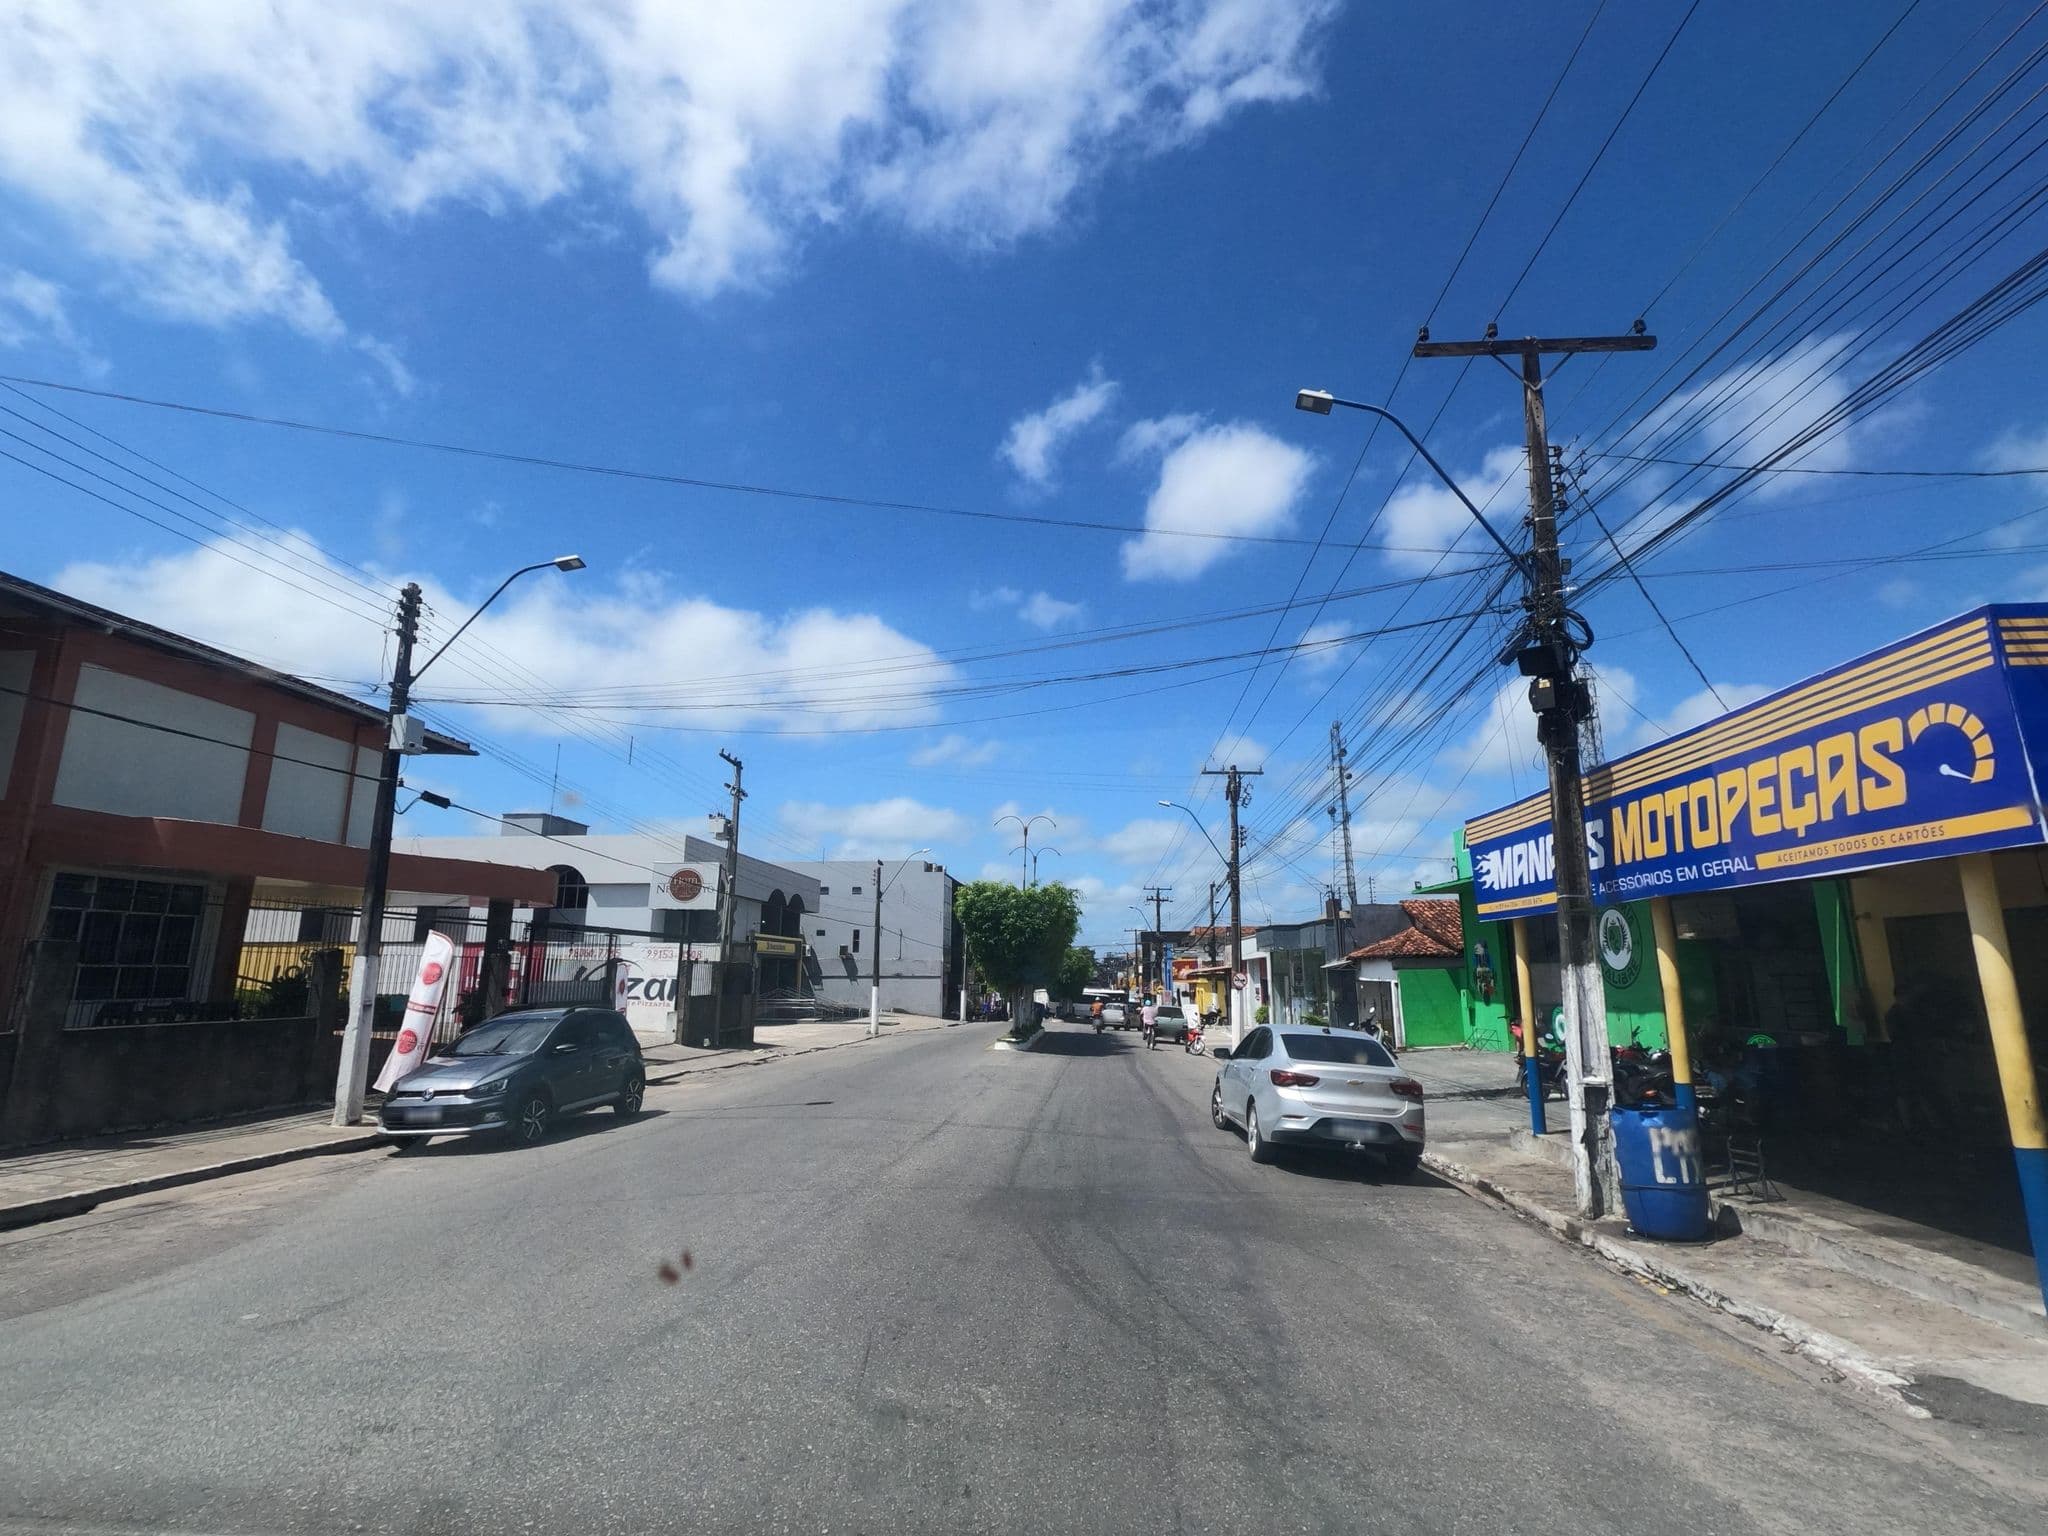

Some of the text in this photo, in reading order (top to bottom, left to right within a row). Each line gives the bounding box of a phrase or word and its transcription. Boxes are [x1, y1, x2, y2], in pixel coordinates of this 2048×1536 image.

[1611, 717, 1907, 866] MOTOPEÇAS
[1777, 825, 1945, 864] ACEITAMOS TODOS OS CARTÕES
[1598, 869, 1673, 896] ACESSÓRIOS
[1677, 865, 1698, 882] EM
[1702, 856, 1755, 878] GERAL
